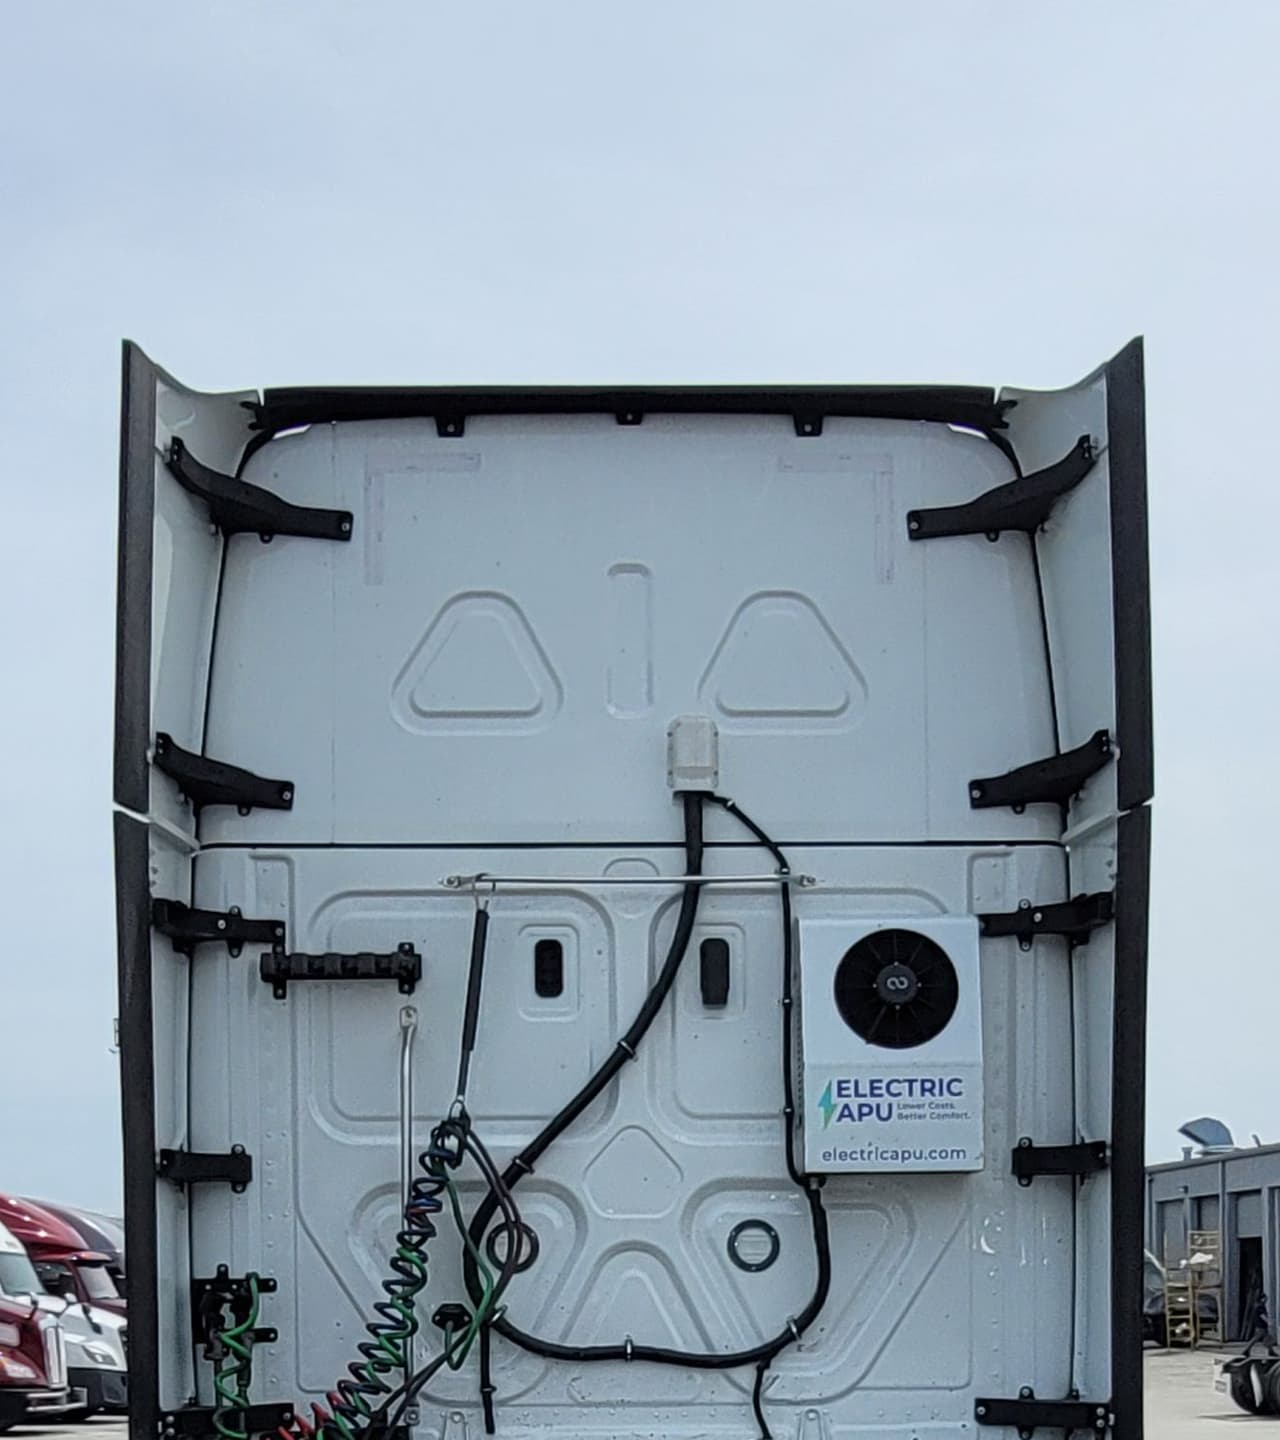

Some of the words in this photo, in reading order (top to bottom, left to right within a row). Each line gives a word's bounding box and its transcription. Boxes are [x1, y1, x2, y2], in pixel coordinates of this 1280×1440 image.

[836, 1078, 963, 1098] ELECTRIC
[836, 1102, 893, 1123] APU
[897, 1102, 926, 1110] Lower
[897, 1112, 927, 1120] Better
[822, 1146, 966, 1163] electricapu.com
